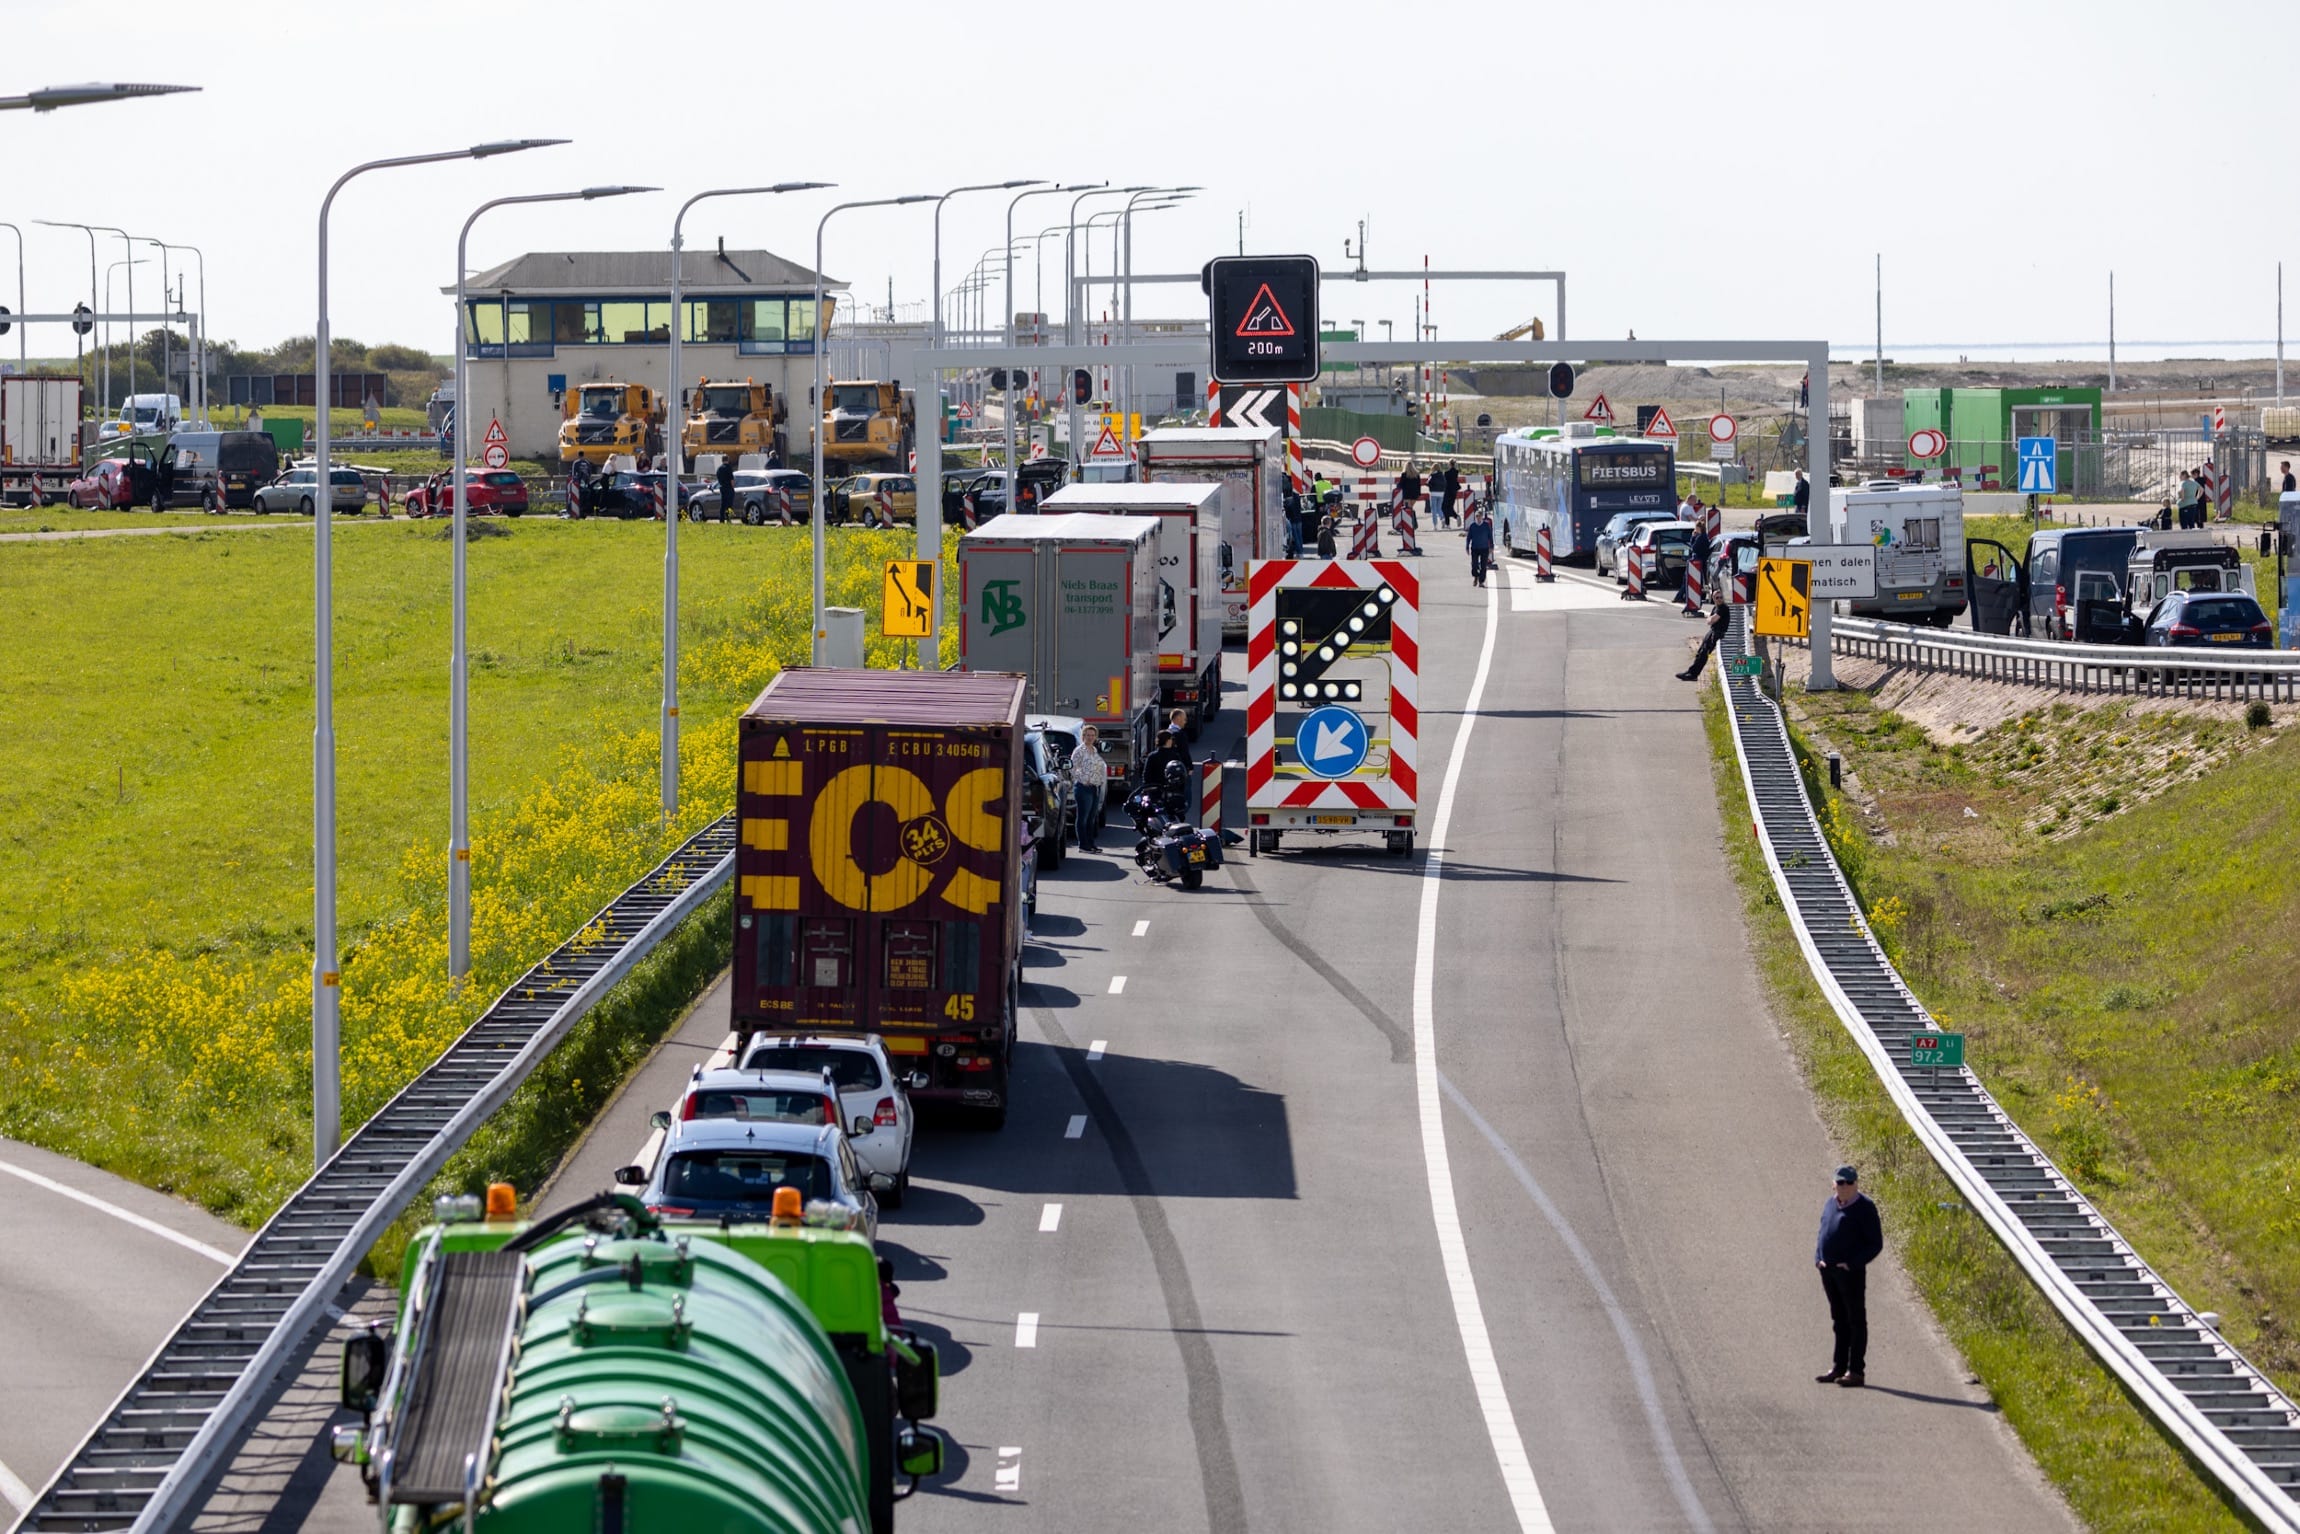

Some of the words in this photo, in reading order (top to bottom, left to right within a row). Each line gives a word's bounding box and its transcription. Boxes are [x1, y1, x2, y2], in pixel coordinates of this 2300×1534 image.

[1248, 341, 1283, 354] 200m
[1592, 466, 1657, 478] FIETSBUS
[1840, 558, 1871, 567] dalen
[1061, 580, 1086, 589] Niels
[1089, 580, 1118, 590] Braas
[1066, 594, 1112, 604] transport
[740, 760, 1005, 915] ECS
[906, 821, 939, 850] 34
[914, 838, 946, 860] PLTS
[944, 994, 975, 1021] 45
[1919, 1039, 1934, 1048] A7
[1915, 1051, 1944, 1063] 97,2
